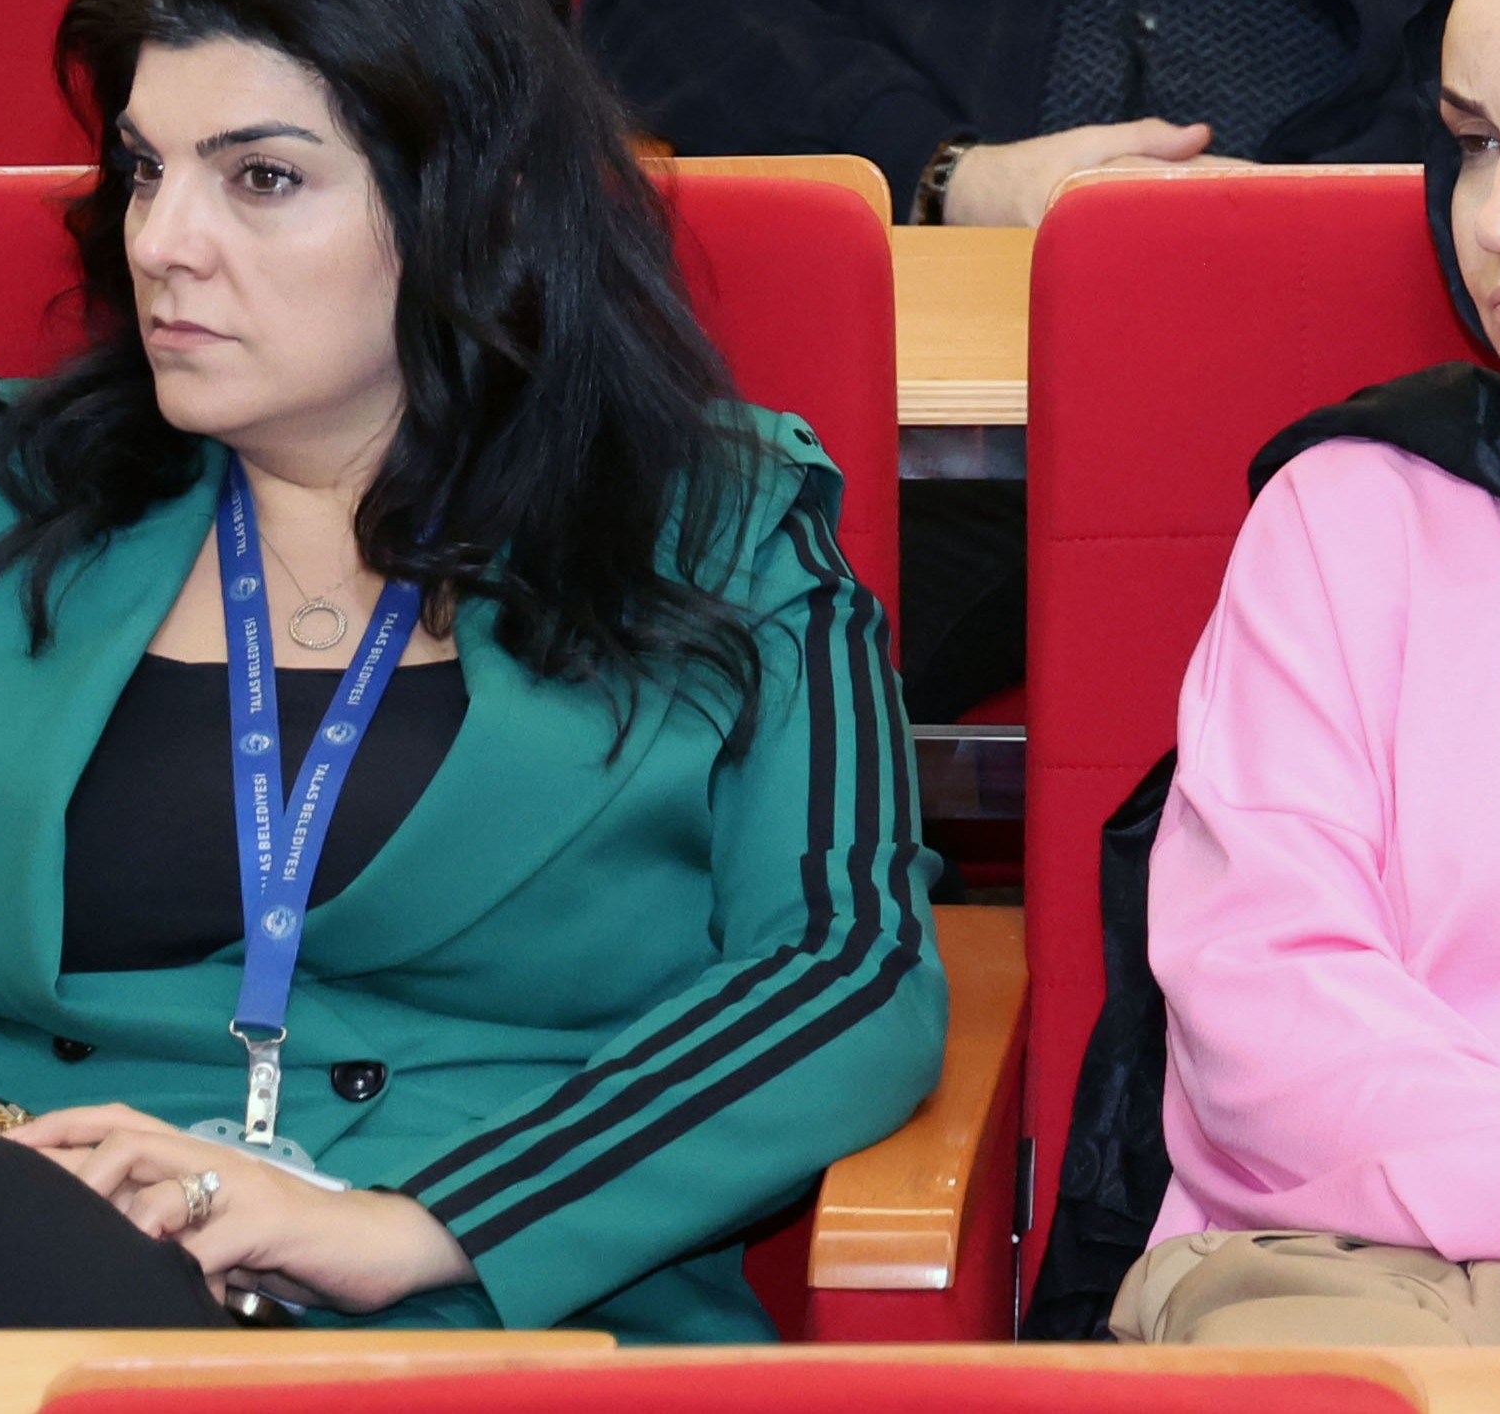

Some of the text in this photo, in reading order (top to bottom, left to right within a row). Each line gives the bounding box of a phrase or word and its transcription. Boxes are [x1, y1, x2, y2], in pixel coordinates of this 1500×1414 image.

[234, 522, 247, 557] TALAS
[375, 612, 398, 646] TALAS
[248, 679, 262, 714] TALAS
[306, 763, 330, 800] TALAS
[252, 773, 271, 851] BELEDİYESİ
